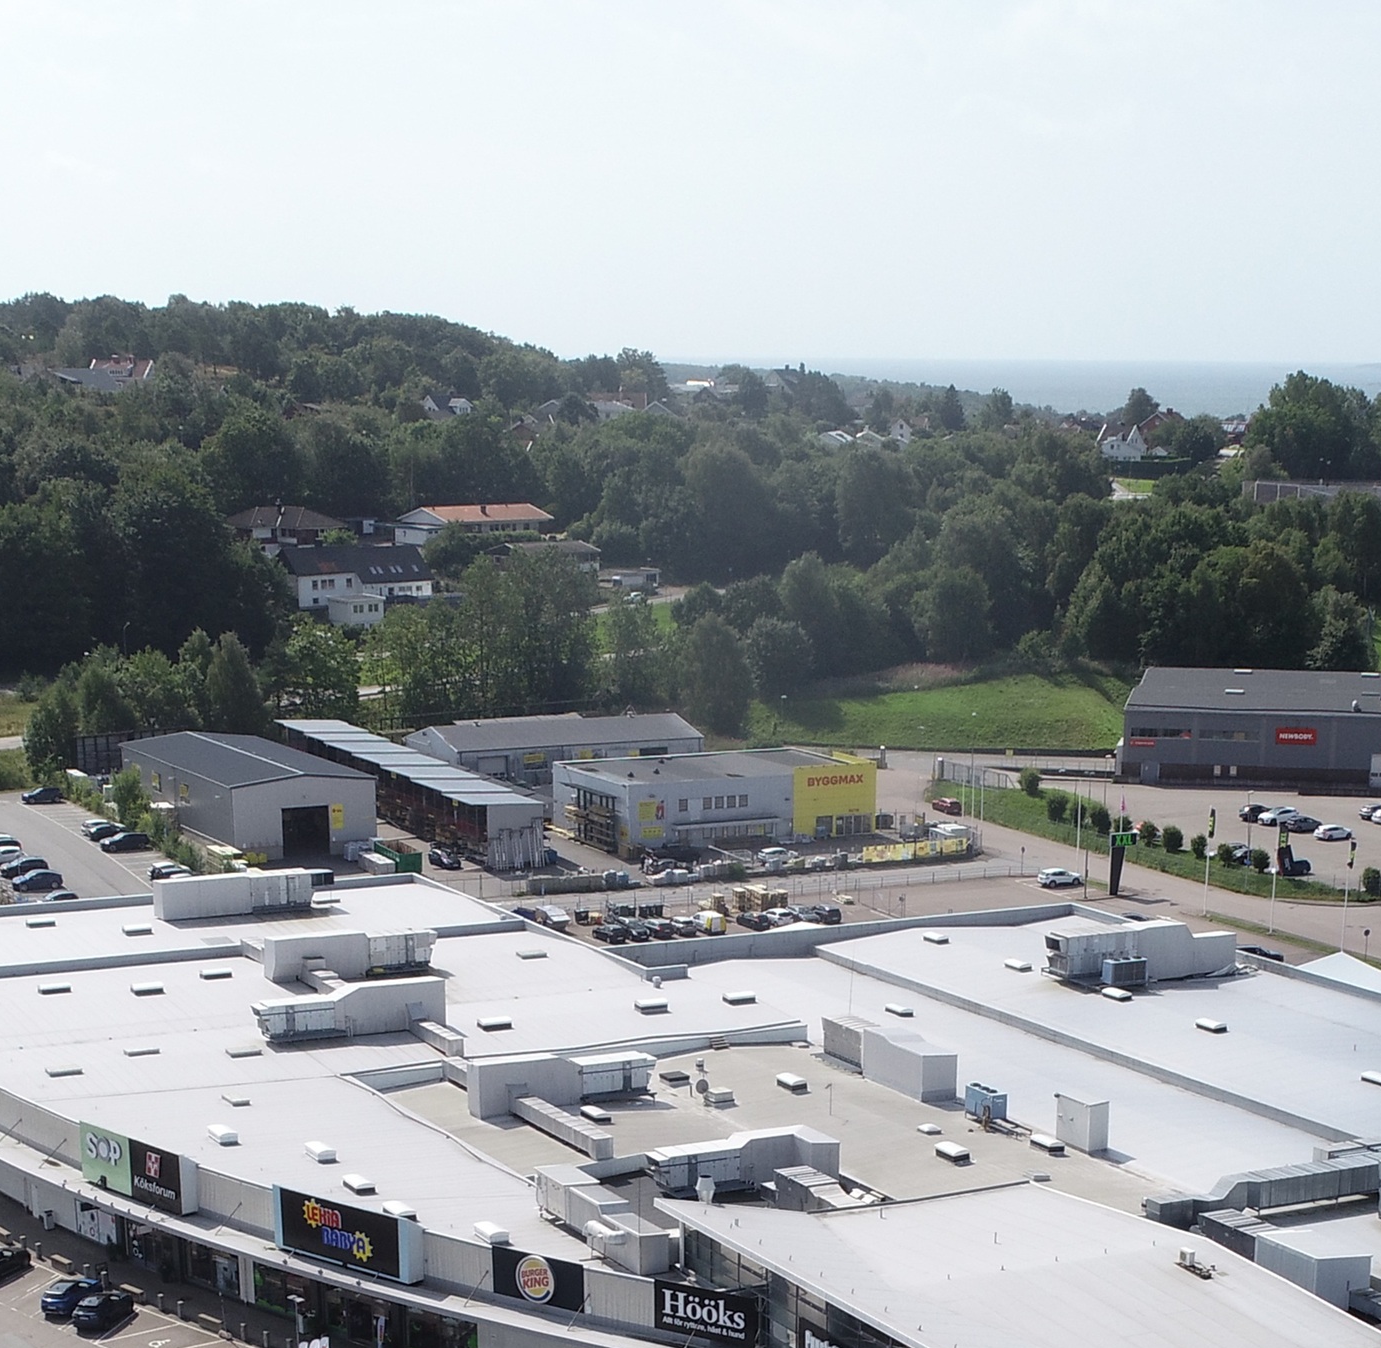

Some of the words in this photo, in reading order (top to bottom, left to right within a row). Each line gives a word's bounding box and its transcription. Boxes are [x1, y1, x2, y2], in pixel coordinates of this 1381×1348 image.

[807, 774, 863, 787] BYGGMAX
[1116, 834, 1133, 846] XXL
[86, 1132, 122, 1166] SOP
[134, 1175, 176, 1200] Köksforum
[306, 1204, 342, 1229] LEKIA
[521, 1267, 548, 1279] BURGER
[523, 1276, 549, 1289] KING
[662, 1288, 745, 1330] Hööks
[728, 1329, 745, 1340] hund
